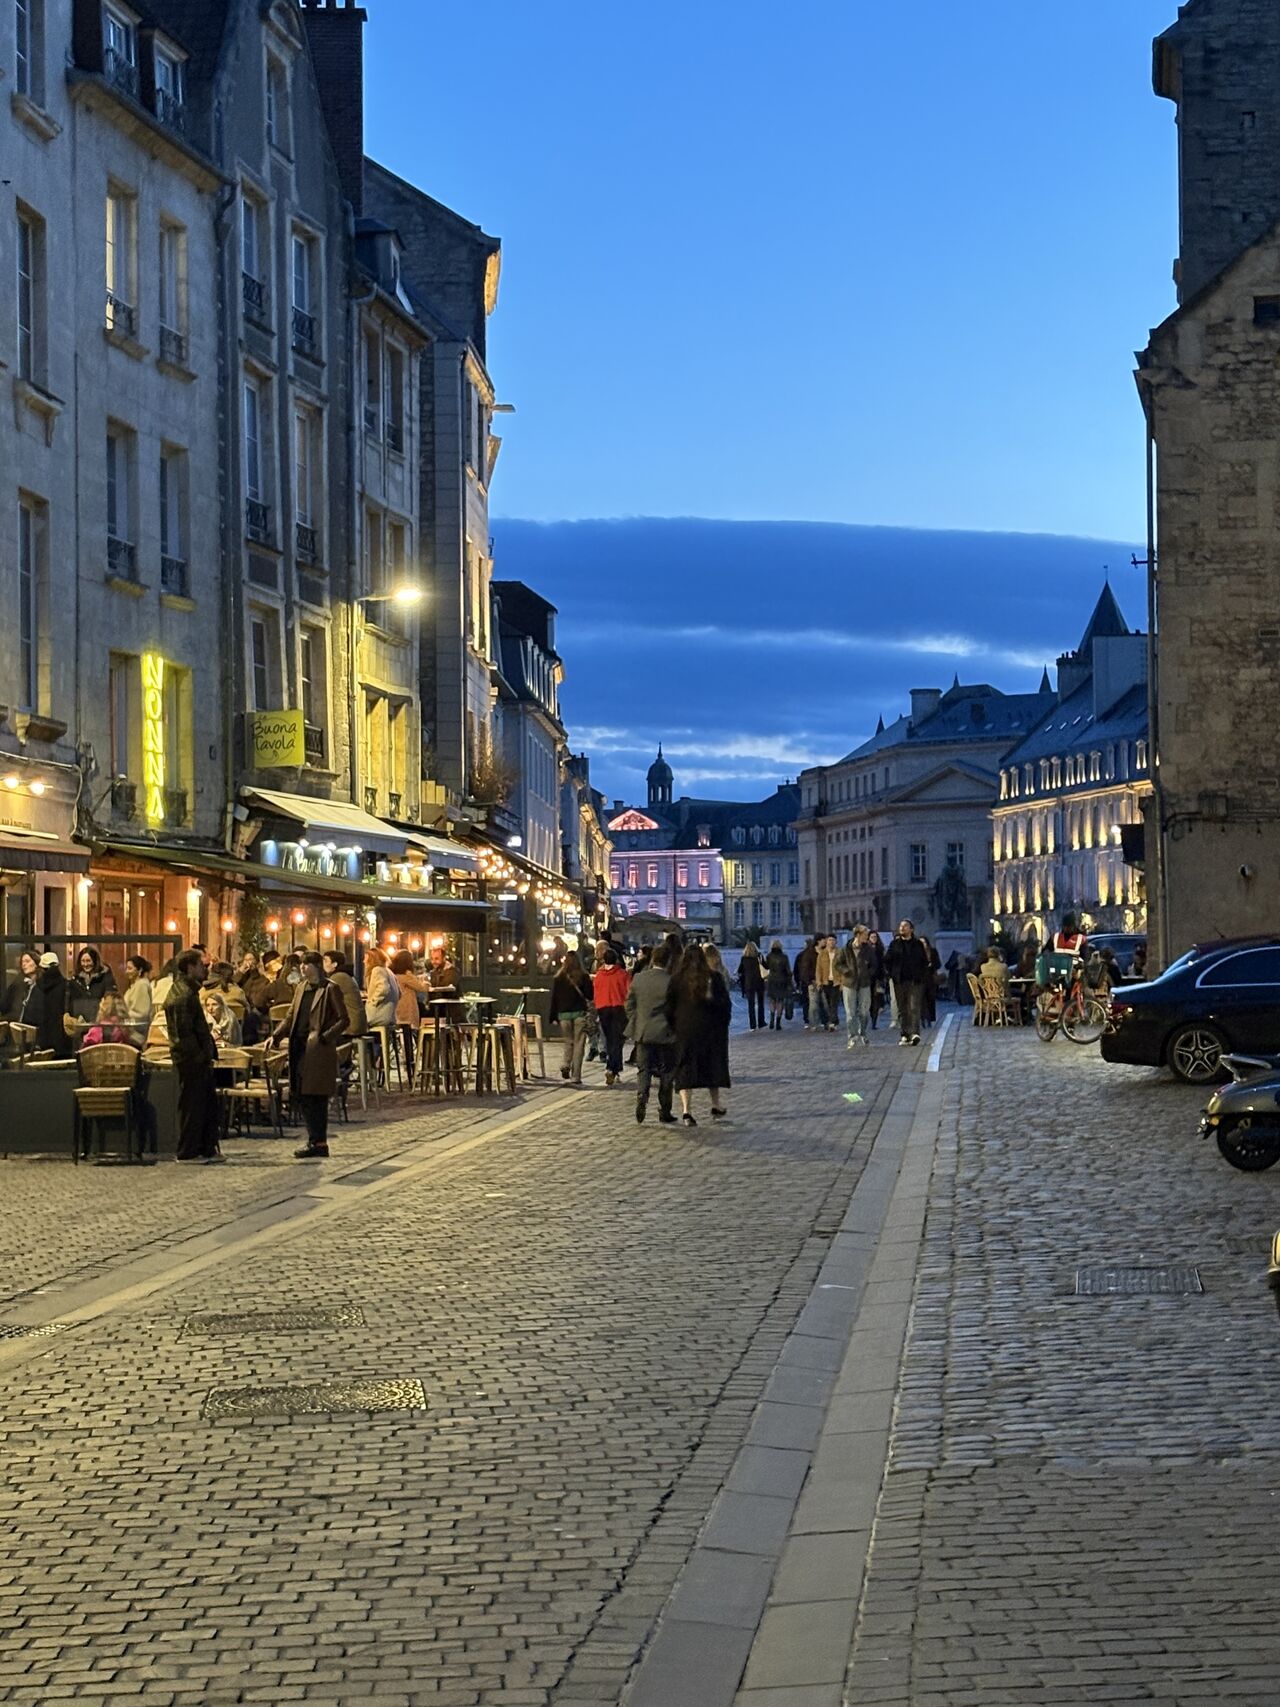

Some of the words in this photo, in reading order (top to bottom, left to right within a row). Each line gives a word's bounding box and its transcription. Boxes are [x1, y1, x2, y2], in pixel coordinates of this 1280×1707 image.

[142, 654, 164, 820] NONNA
[251, 721, 298, 737] Buona
[253, 735, 296, 751] Tavola
